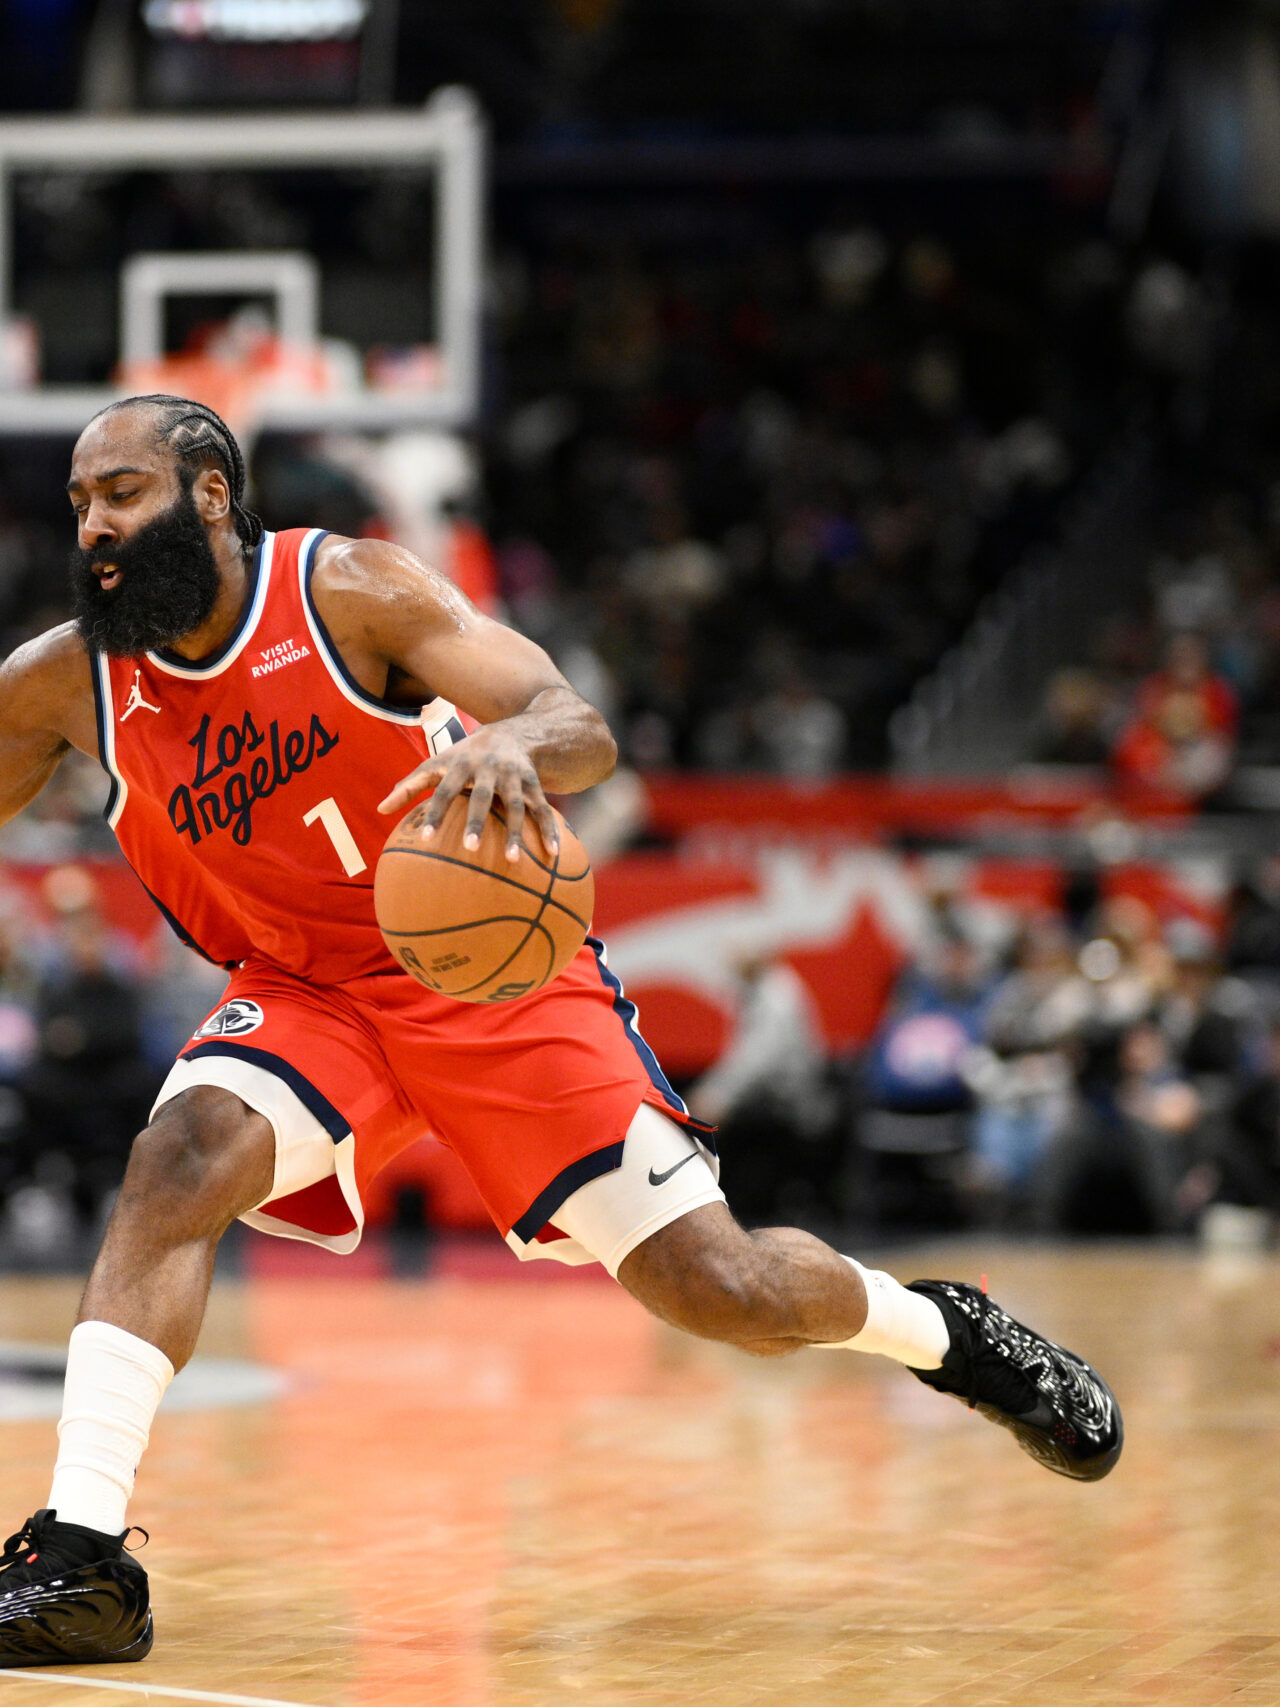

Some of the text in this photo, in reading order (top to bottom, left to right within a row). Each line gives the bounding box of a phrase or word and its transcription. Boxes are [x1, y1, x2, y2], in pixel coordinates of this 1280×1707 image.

[251, 645, 311, 678] RWANDA
[260, 639, 294, 661] VISIT
[168, 713, 340, 846] Angeles
[188, 709, 265, 789] Los
[302, 797, 368, 878] 1
